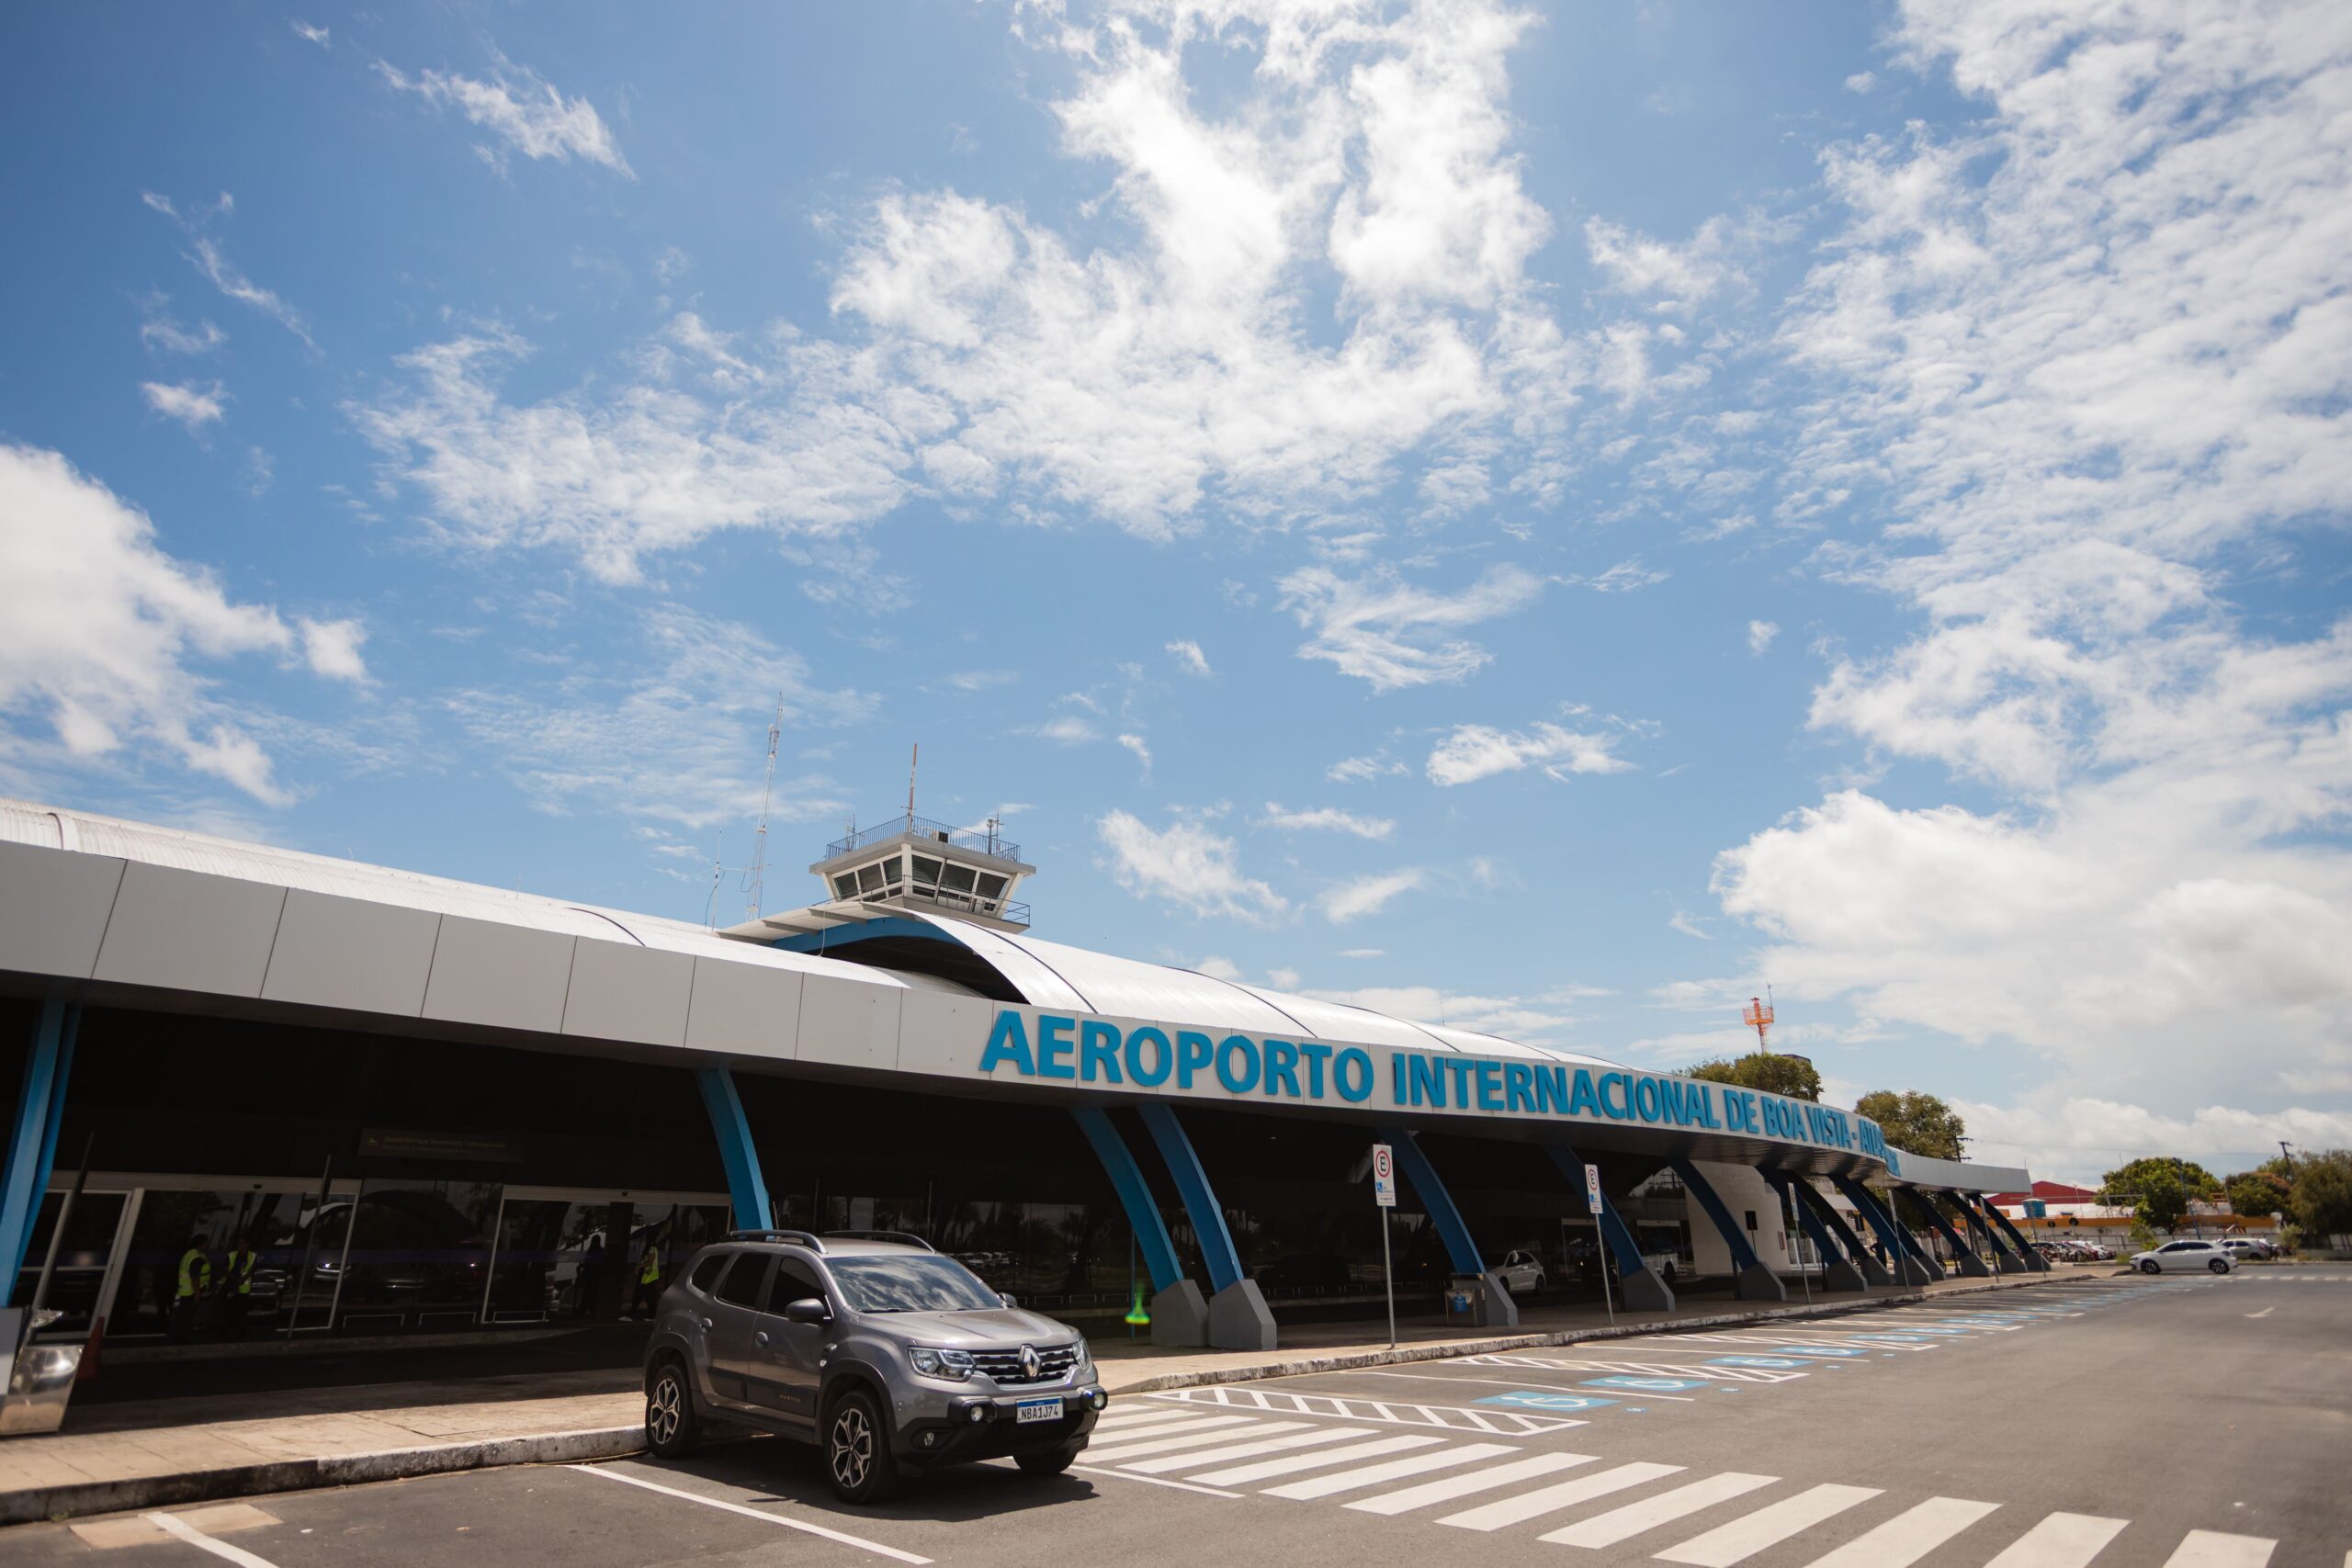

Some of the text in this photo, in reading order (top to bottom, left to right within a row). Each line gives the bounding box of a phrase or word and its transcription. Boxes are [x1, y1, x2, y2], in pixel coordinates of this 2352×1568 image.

[979, 1009, 1374, 1103] AEROPORTO
[1392, 1052, 1722, 1129] INTERNACIONAL
[1723, 1089, 1760, 1134] DE
[1761, 1096, 1808, 1141] BOA
[1804, 1106, 1852, 1148] VISTA
[1858, 1118, 1886, 1159] ATLA
[1379, 1156, 1386, 1172] E
[1021, 1405, 1058, 1420] NBA1J74
